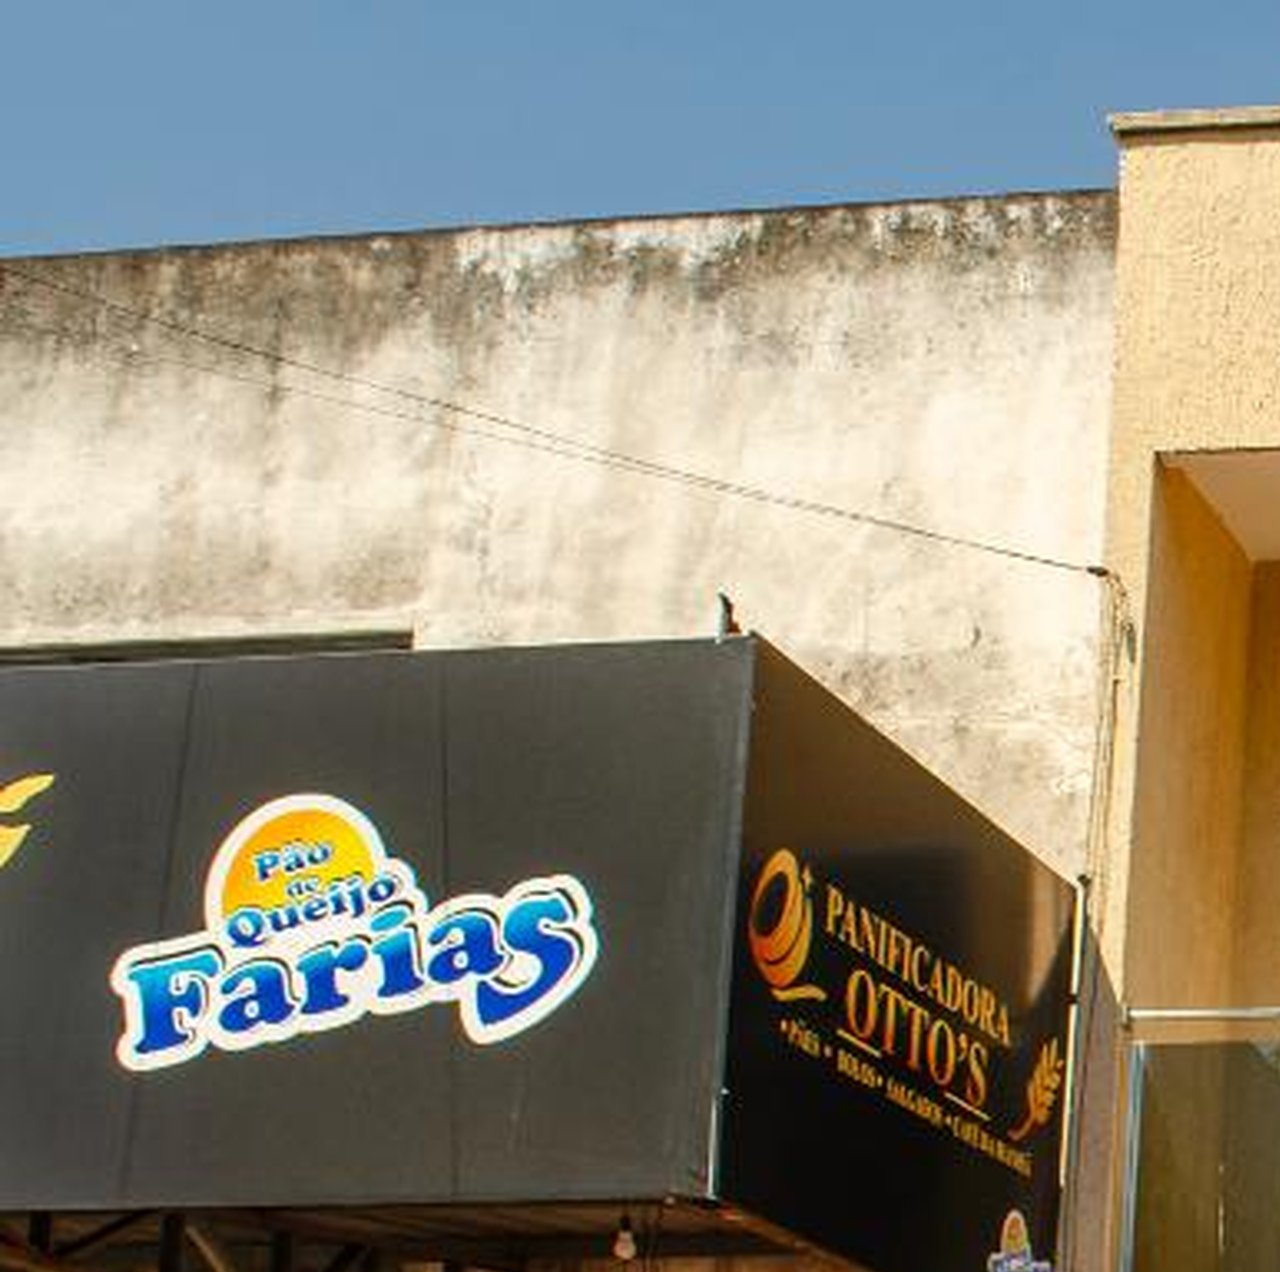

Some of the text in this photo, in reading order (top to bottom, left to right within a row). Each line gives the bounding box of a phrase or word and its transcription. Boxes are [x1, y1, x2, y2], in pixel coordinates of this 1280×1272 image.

[254, 839, 334, 881] Pão
[286, 874, 318, 898] de
[227, 872, 400, 949] Queijo
[129, 887, 582, 1053] Farias
[826, 883, 1010, 1048] PANIFICADORA
